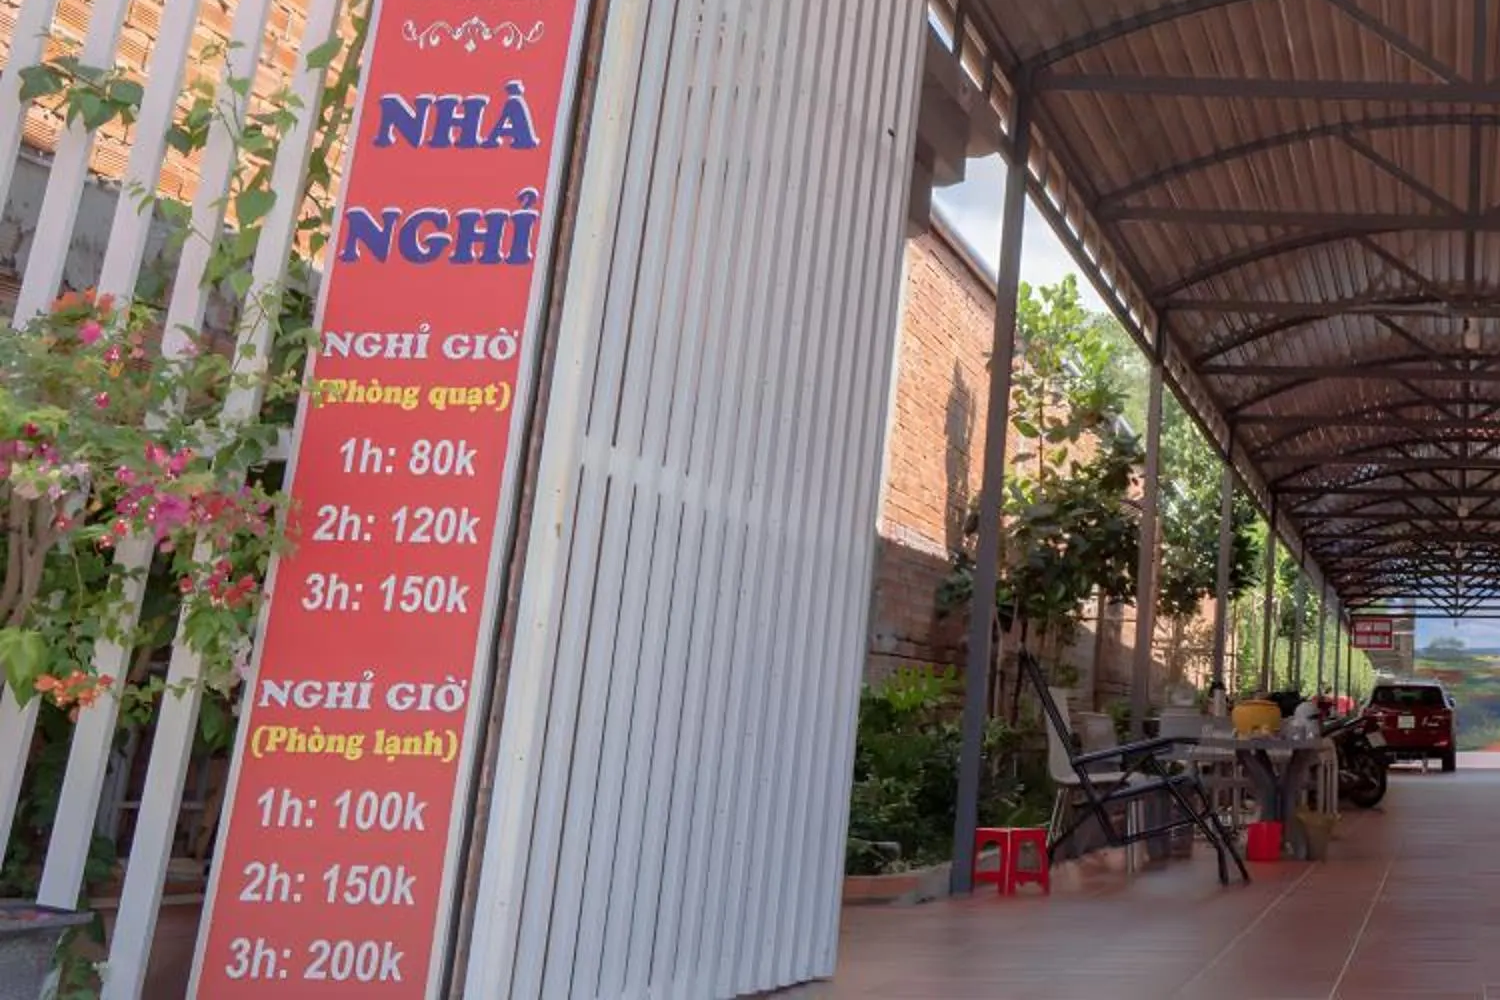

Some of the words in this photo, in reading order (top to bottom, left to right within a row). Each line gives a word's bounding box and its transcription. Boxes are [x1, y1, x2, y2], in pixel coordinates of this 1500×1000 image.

[372, 79, 542, 150] NHÀ
[338, 186, 542, 265] NGHỈ
[322, 323, 432, 359] NGHỈ
[441, 326, 519, 360] GIỜ
[428, 381, 511, 412] quạt)
[339, 437, 396, 473] 1h:
[408, 439, 478, 476] 80k
[312, 504, 376, 541] 2h:
[391, 506, 481, 544] 120k
[302, 573, 363, 611] 3h:
[379, 574, 471, 613] 150k
[257, 669, 375, 709] NGHỈ
[386, 676, 467, 712] GIỜ
[251, 725, 365, 760] (Phòng
[373, 729, 459, 763] lạnh)
[257, 787, 317, 828] 1h:
[334, 790, 428, 832] 100k
[239, 861, 305, 903] 2h:
[322, 864, 417, 906] 150k
[225, 937, 291, 979] 3h:
[303, 939, 405, 982] 200k
